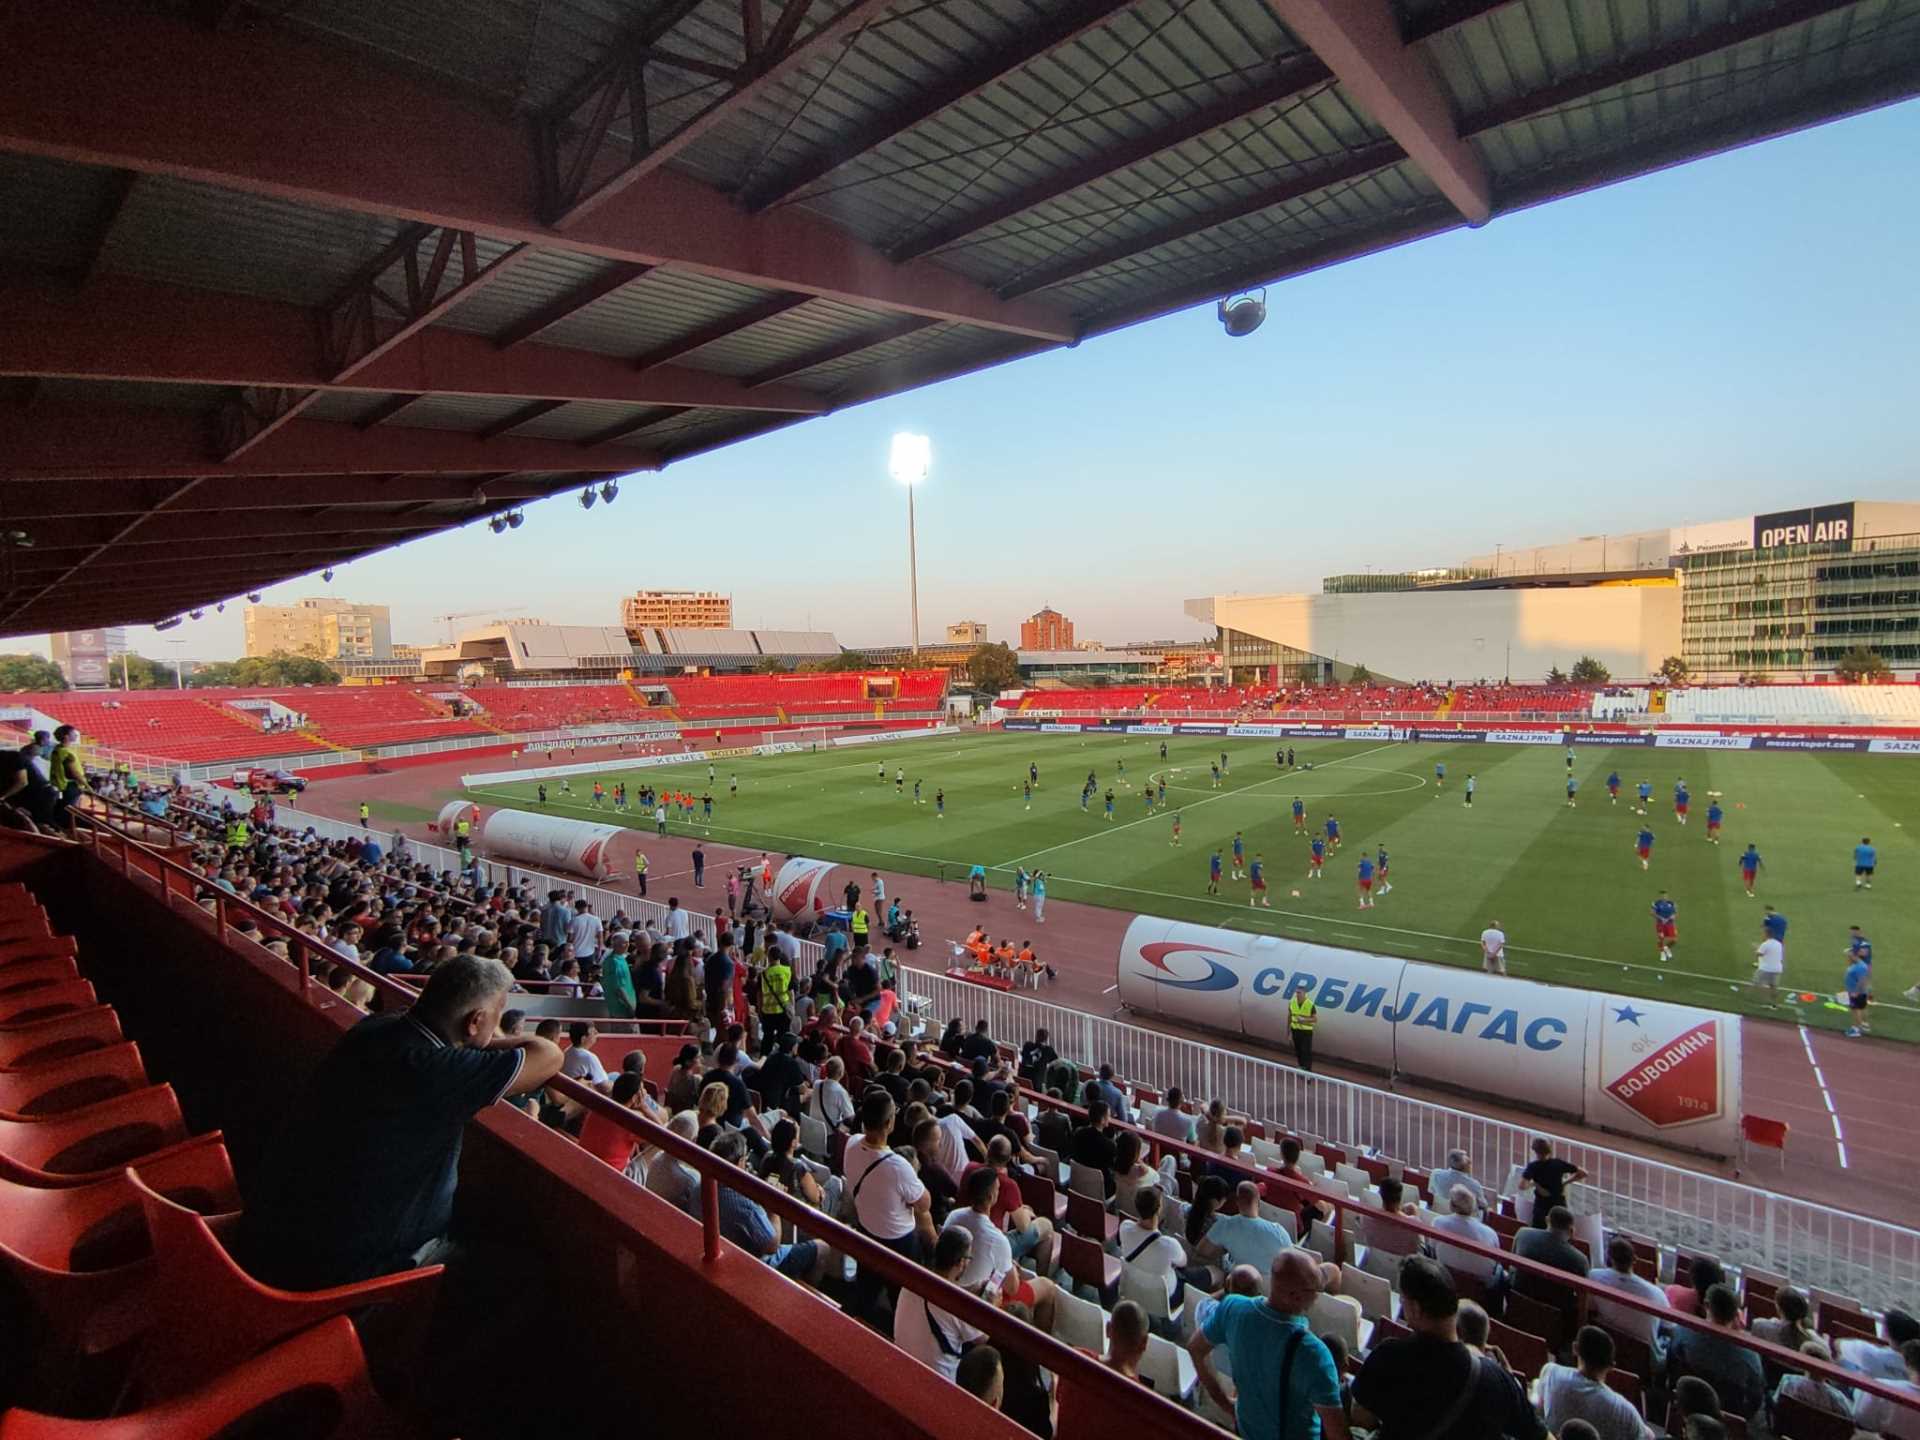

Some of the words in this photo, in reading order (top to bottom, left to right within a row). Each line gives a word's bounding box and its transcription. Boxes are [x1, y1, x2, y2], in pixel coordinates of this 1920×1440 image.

[1762, 524, 1809, 548] OPEN
[1814, 519, 1848, 542] AIR
[1696, 539, 1748, 552] Promenada
[1666, 737, 1710, 745] SAZNAJ
[1711, 738, 1738, 746] PRVI
[1765, 740, 1855, 749] mozzartsport.com
[1253, 967, 1568, 1051] СРБИЈАГАС
[1631, 1033, 1657, 1053] ФК
[1617, 1031, 1713, 1098] ВОЈВОДИНА
[1677, 1095, 1709, 1112] 1914
